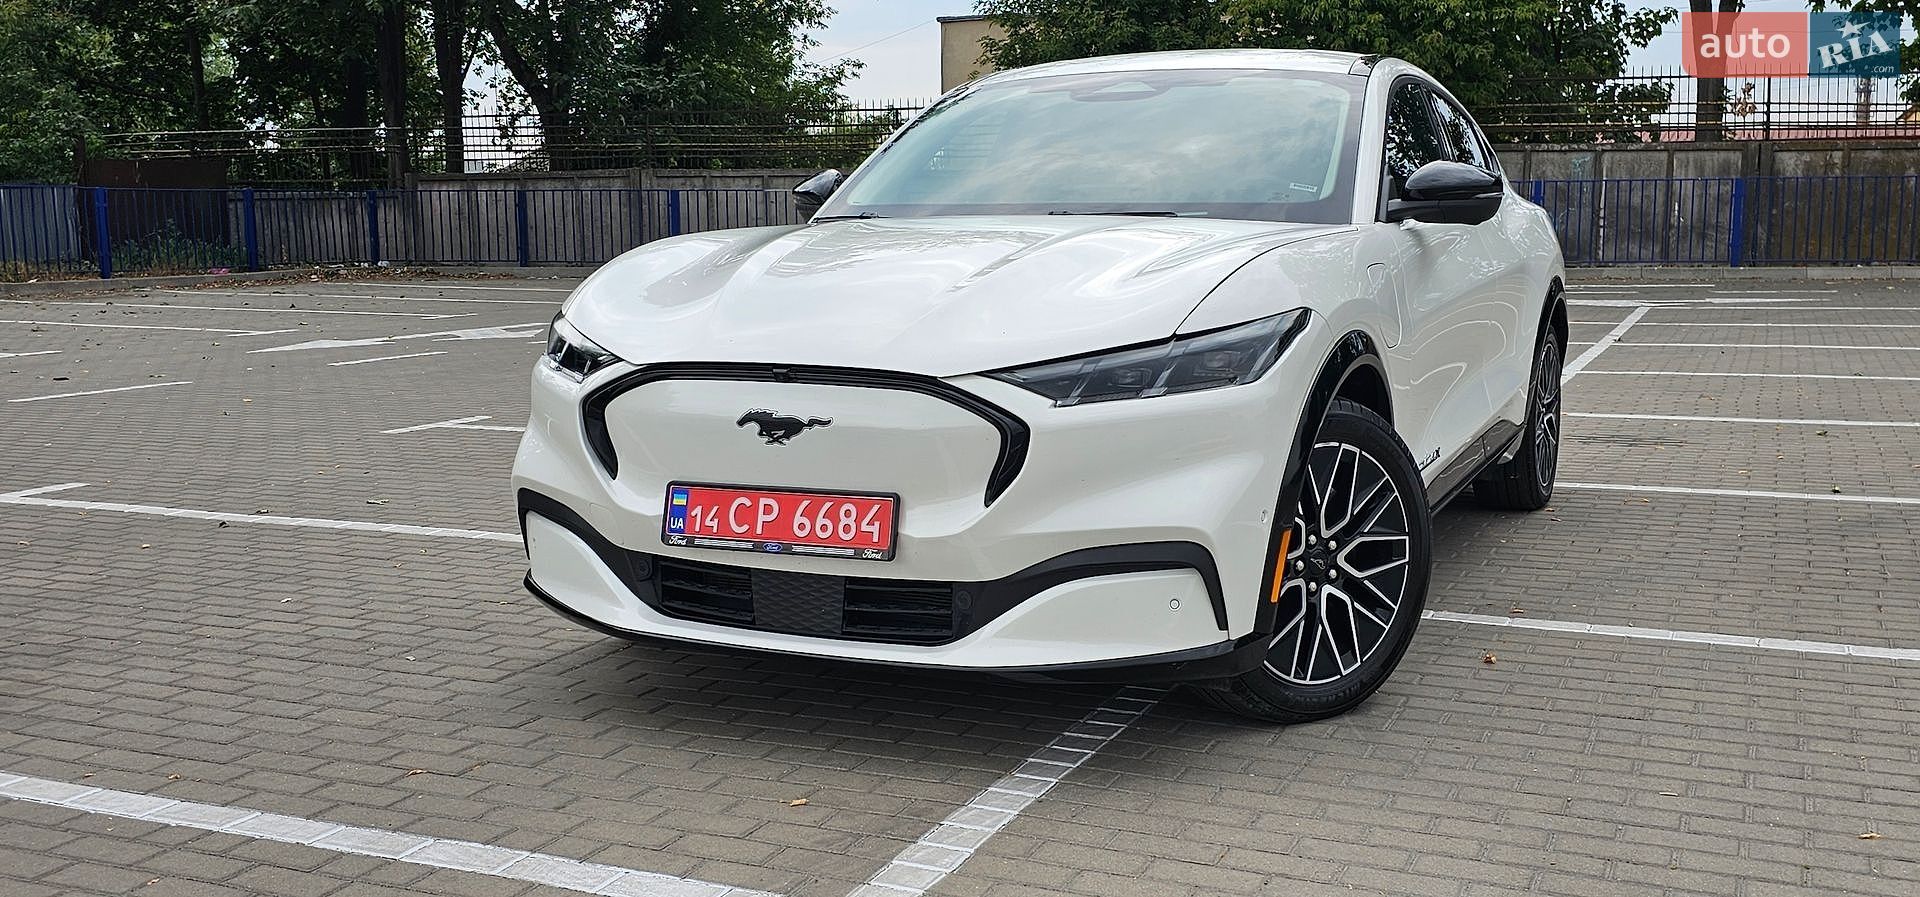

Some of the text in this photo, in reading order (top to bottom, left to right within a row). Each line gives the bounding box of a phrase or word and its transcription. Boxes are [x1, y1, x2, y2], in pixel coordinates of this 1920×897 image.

[670, 517, 684, 530] UA
[690, 496, 882, 543] 14 CP 6684
[669, 535, 688, 546] Ford
[862, 548, 883, 560] Ford
